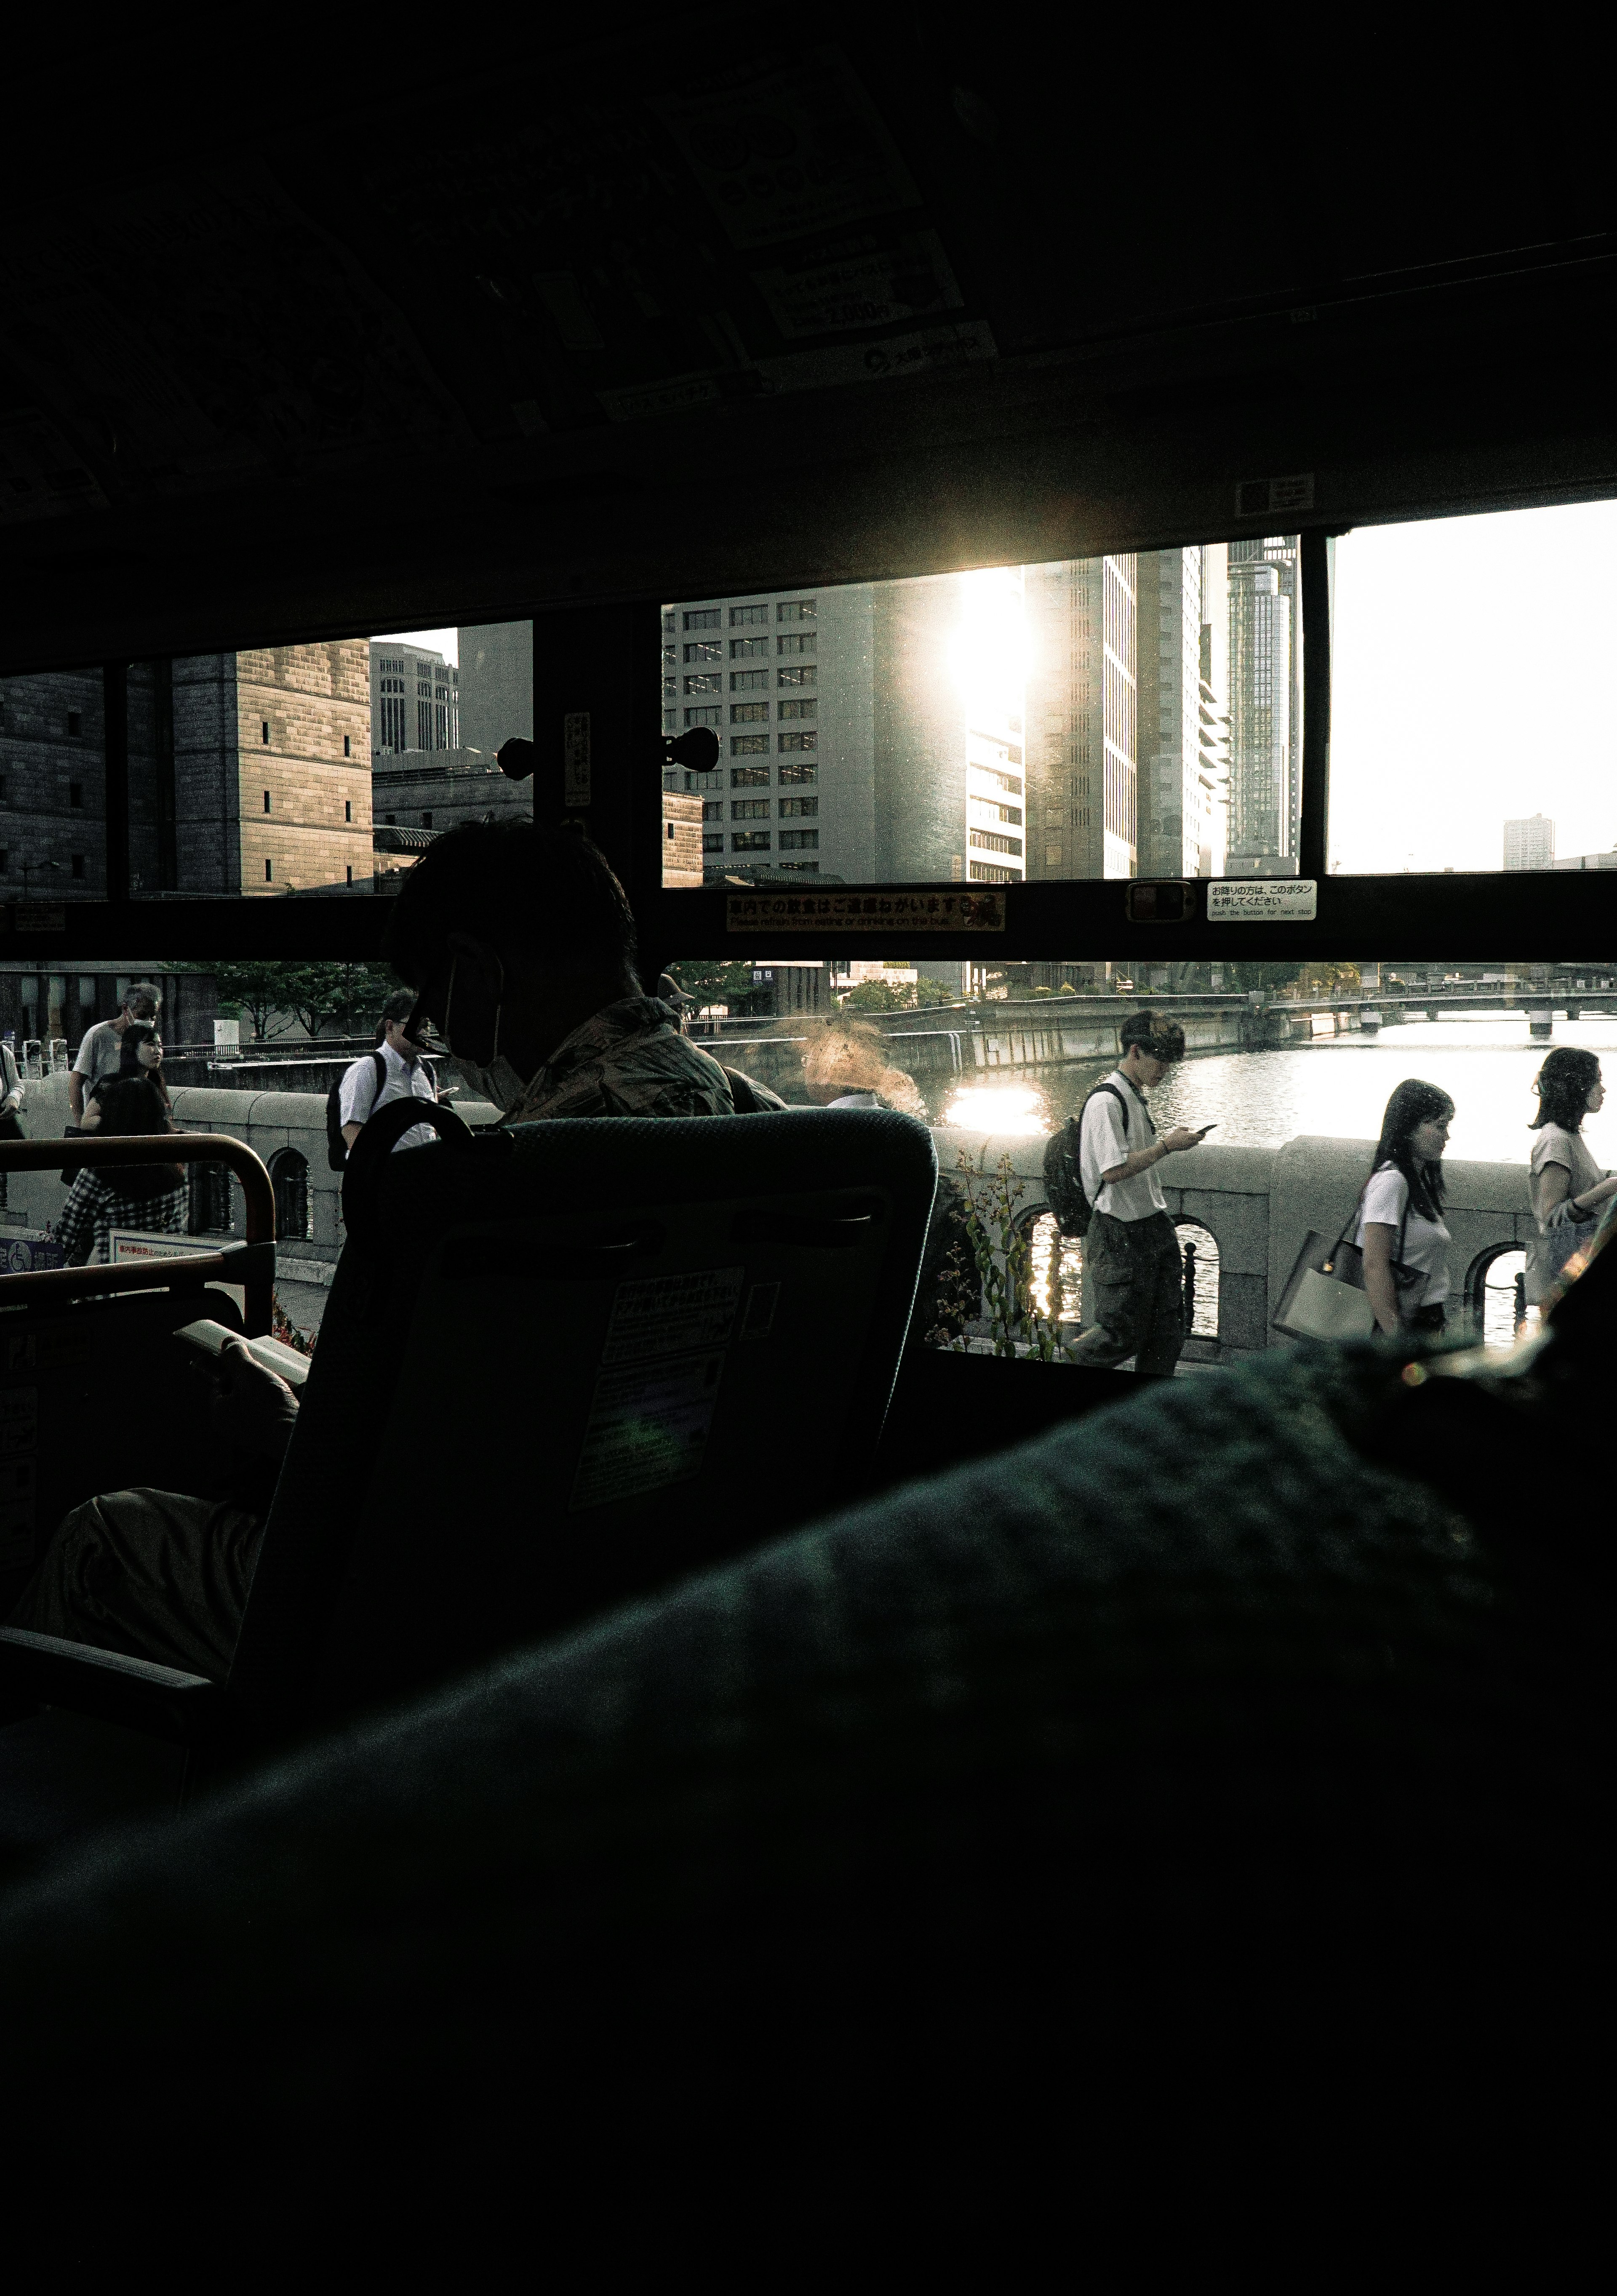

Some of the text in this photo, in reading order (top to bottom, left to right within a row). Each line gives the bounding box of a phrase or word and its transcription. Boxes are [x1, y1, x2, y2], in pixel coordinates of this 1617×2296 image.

[1212, 885, 1312, 896] お降りの方は、このボタン
[1212, 896, 1281, 907] を押してください
